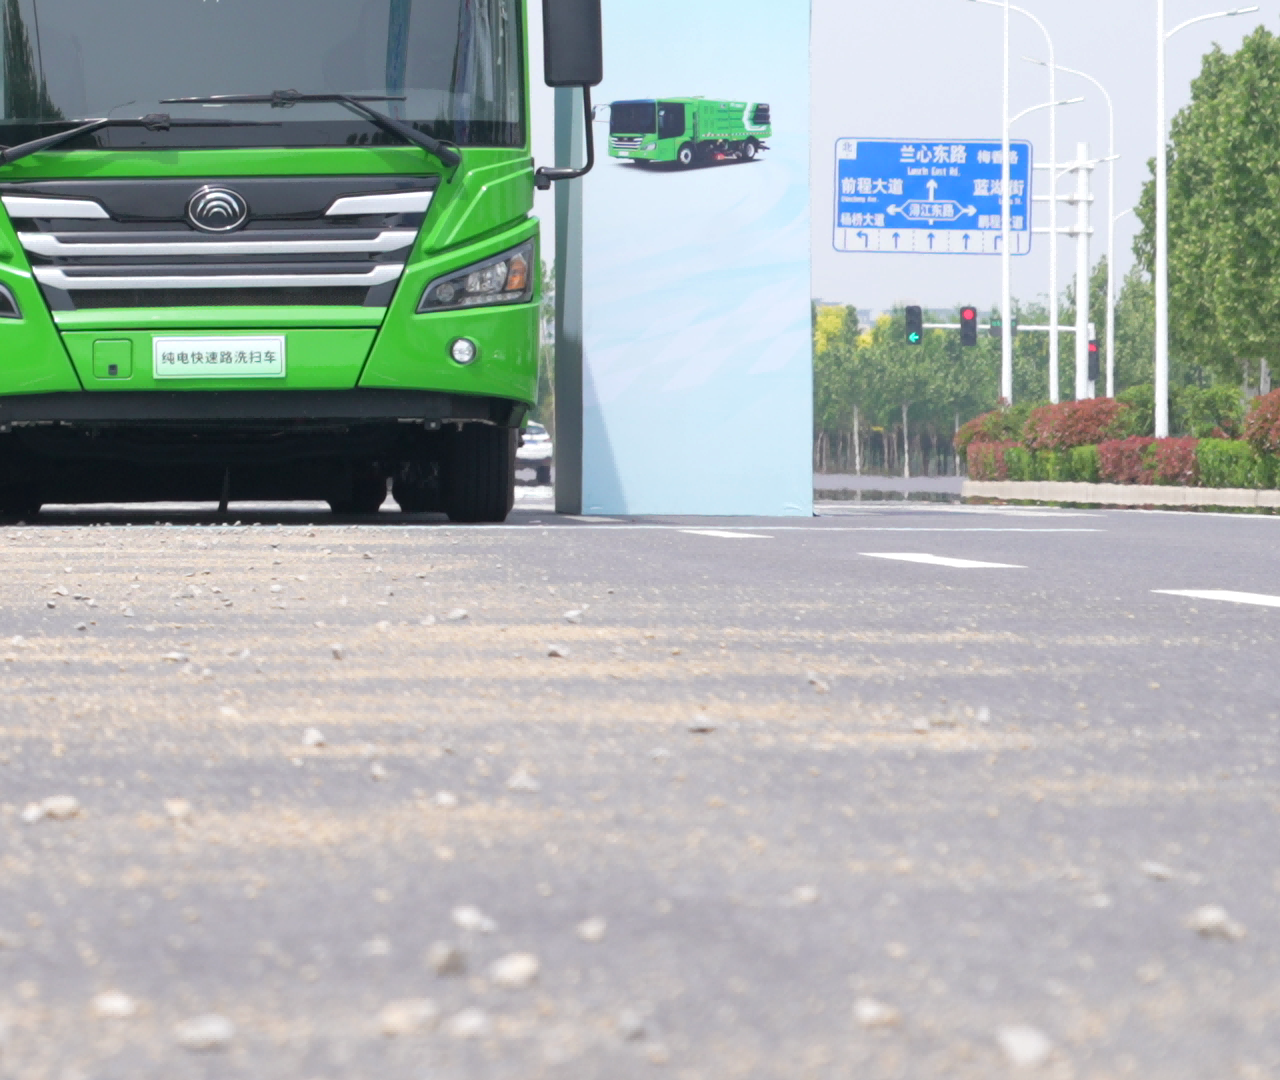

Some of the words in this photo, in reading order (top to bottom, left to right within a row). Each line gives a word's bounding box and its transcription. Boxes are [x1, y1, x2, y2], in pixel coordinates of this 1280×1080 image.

[899, 144, 967, 164] 兰心东路
[841, 177, 904, 195] 前程大道
[161, 350, 277, 365] 纯电快速路洗扫车
